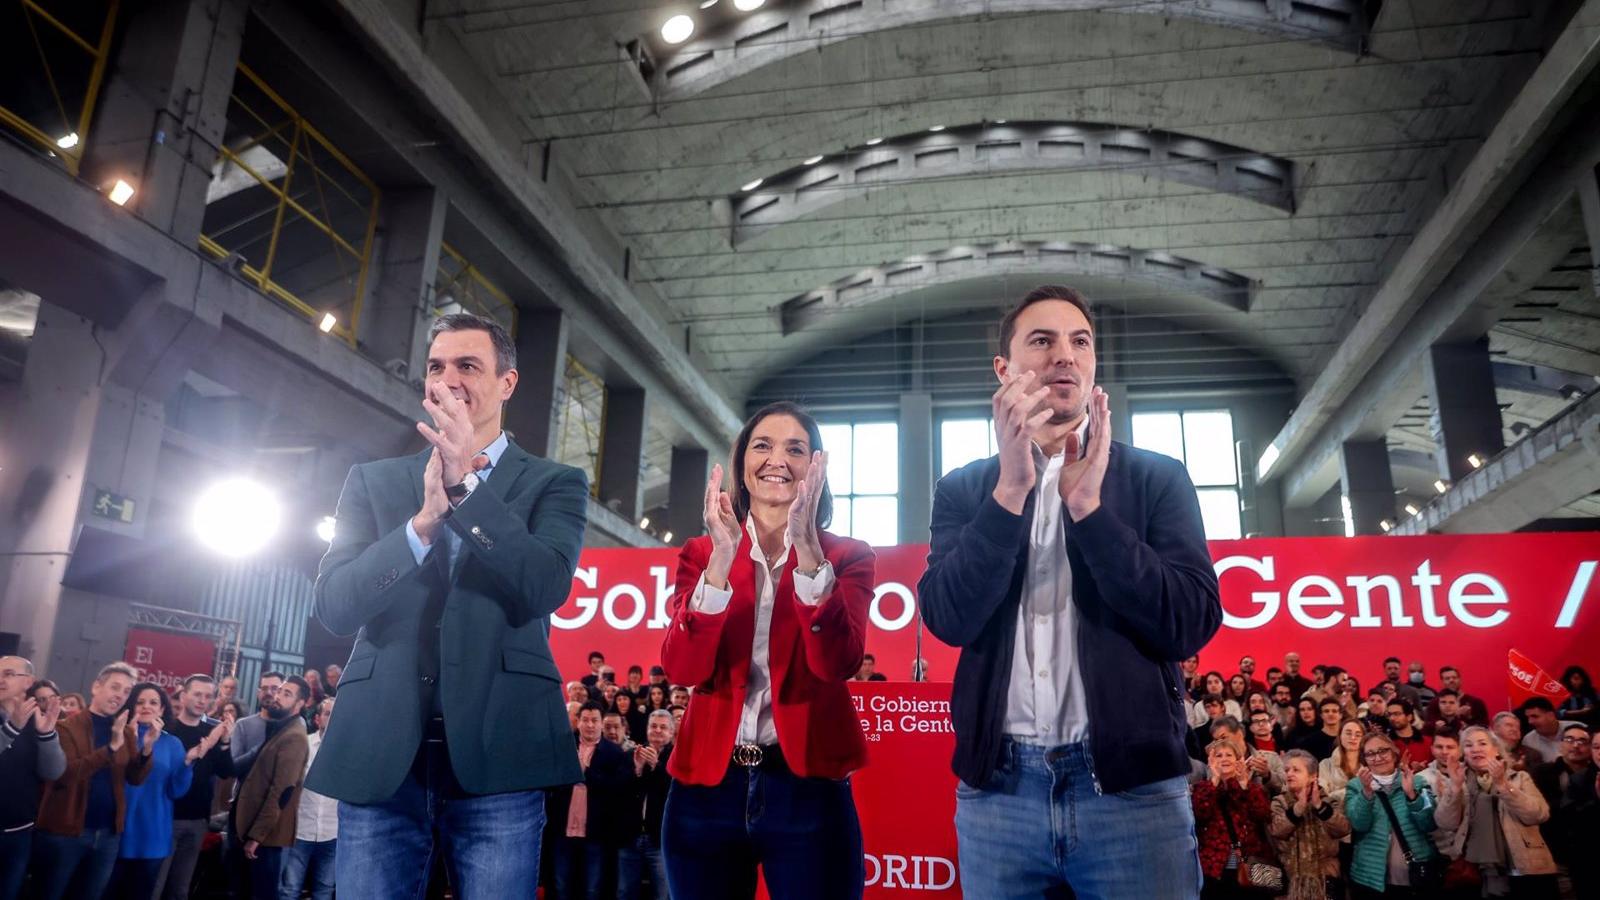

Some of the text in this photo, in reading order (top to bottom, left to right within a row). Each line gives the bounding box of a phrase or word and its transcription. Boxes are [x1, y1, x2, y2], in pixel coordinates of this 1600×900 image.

[1213, 555, 1511, 630] Gente
[135, 646, 154, 665] El
[137, 667, 182, 688] Gobie
[870, 695, 952, 713] Gobiern
[860, 718, 871, 732] e
[876, 714, 894, 732] la
[863, 853, 956, 890] DRID
